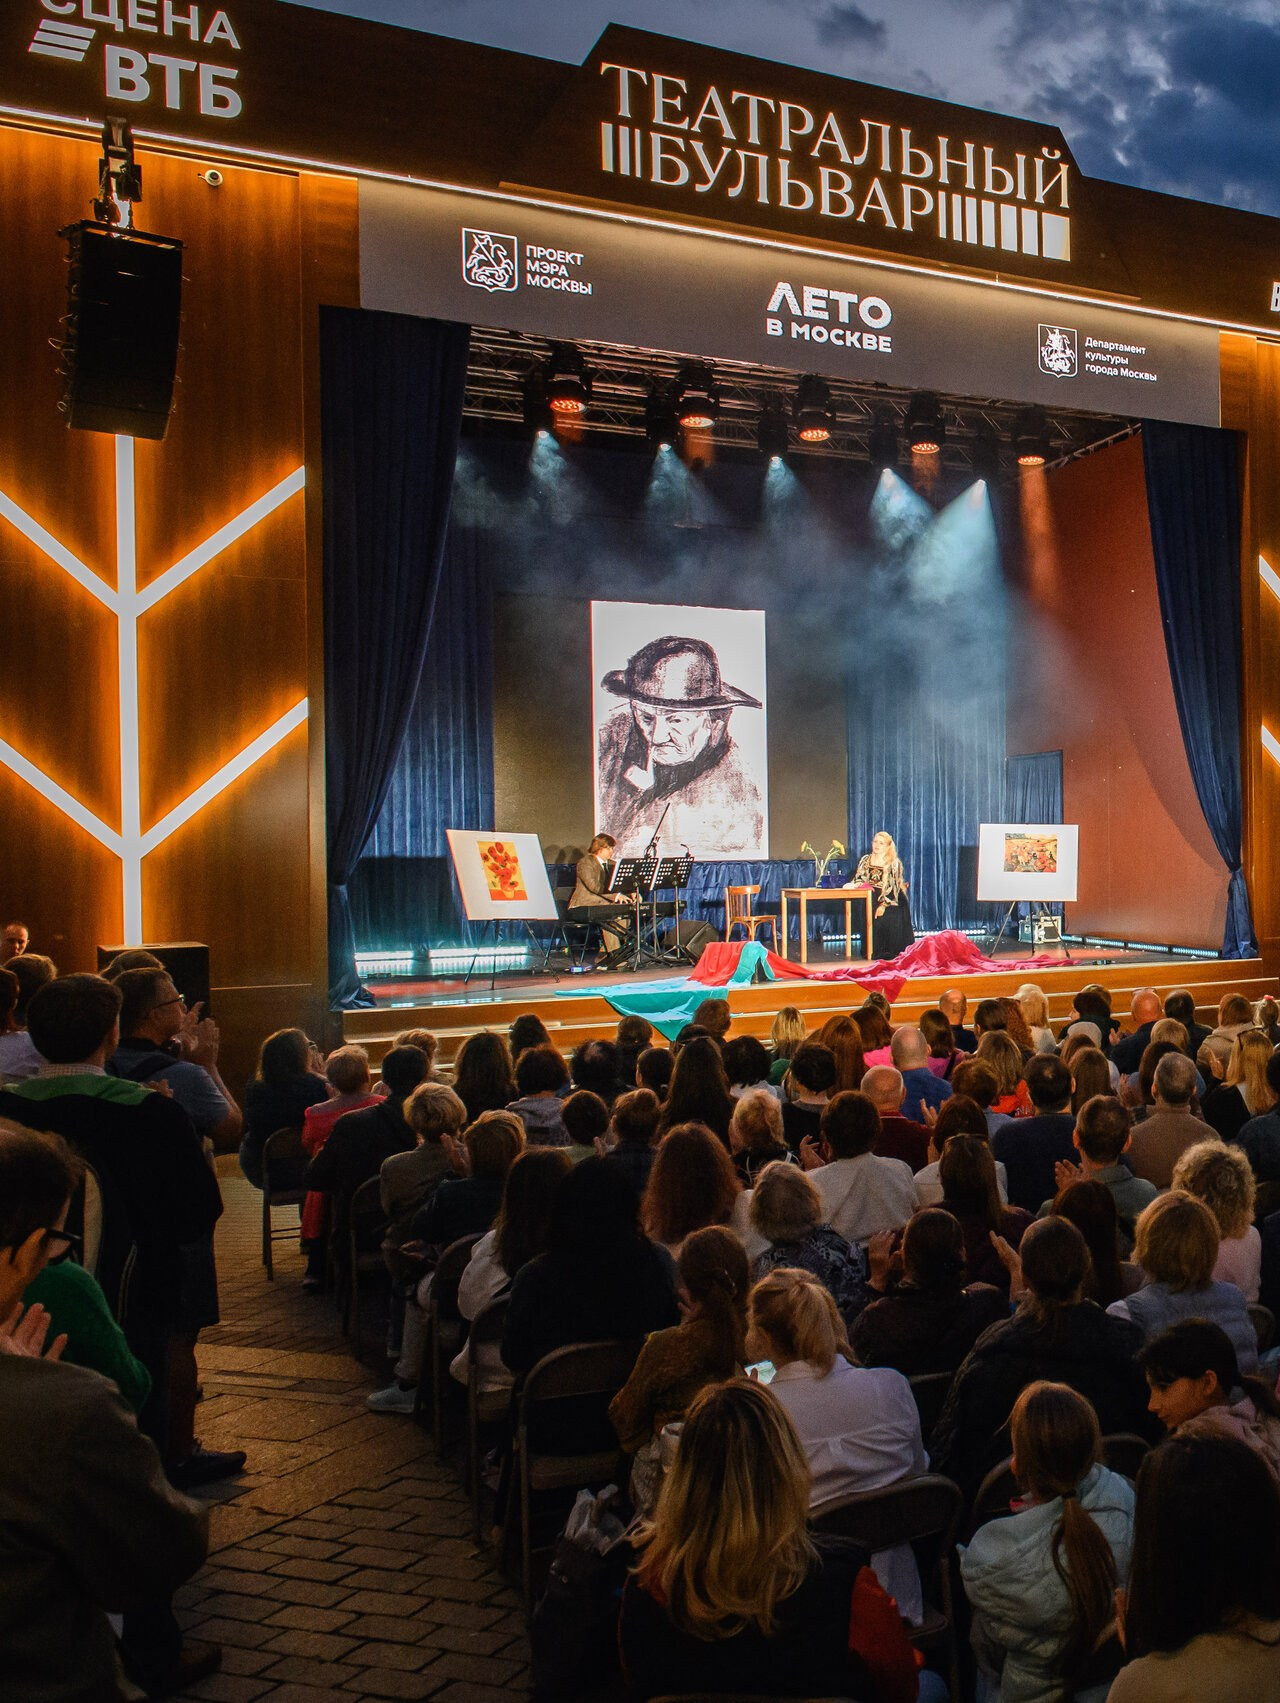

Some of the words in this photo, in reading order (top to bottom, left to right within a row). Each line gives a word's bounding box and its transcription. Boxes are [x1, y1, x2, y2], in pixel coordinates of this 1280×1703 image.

[105, 44, 242, 118] ВТБ
[601, 62, 1069, 208] ТЕАТРАЛЬНЫЙ
[650, 131, 934, 231] БУЛЬВАР
[526, 245, 584, 265] ПРОЕКТ
[526, 259, 569, 277] МЭРА
[526, 273, 593, 295] МОСКВЫ
[766, 281, 892, 329] ЛЕТО
[766, 318, 783, 336] В
[790, 321, 892, 353] МОСКВЕ
[1085, 337, 1146, 355] Департамент
[1085, 351, 1129, 365] культуры
[1085, 363, 1118, 376] города
[1120, 368, 1157, 381] Москвы
